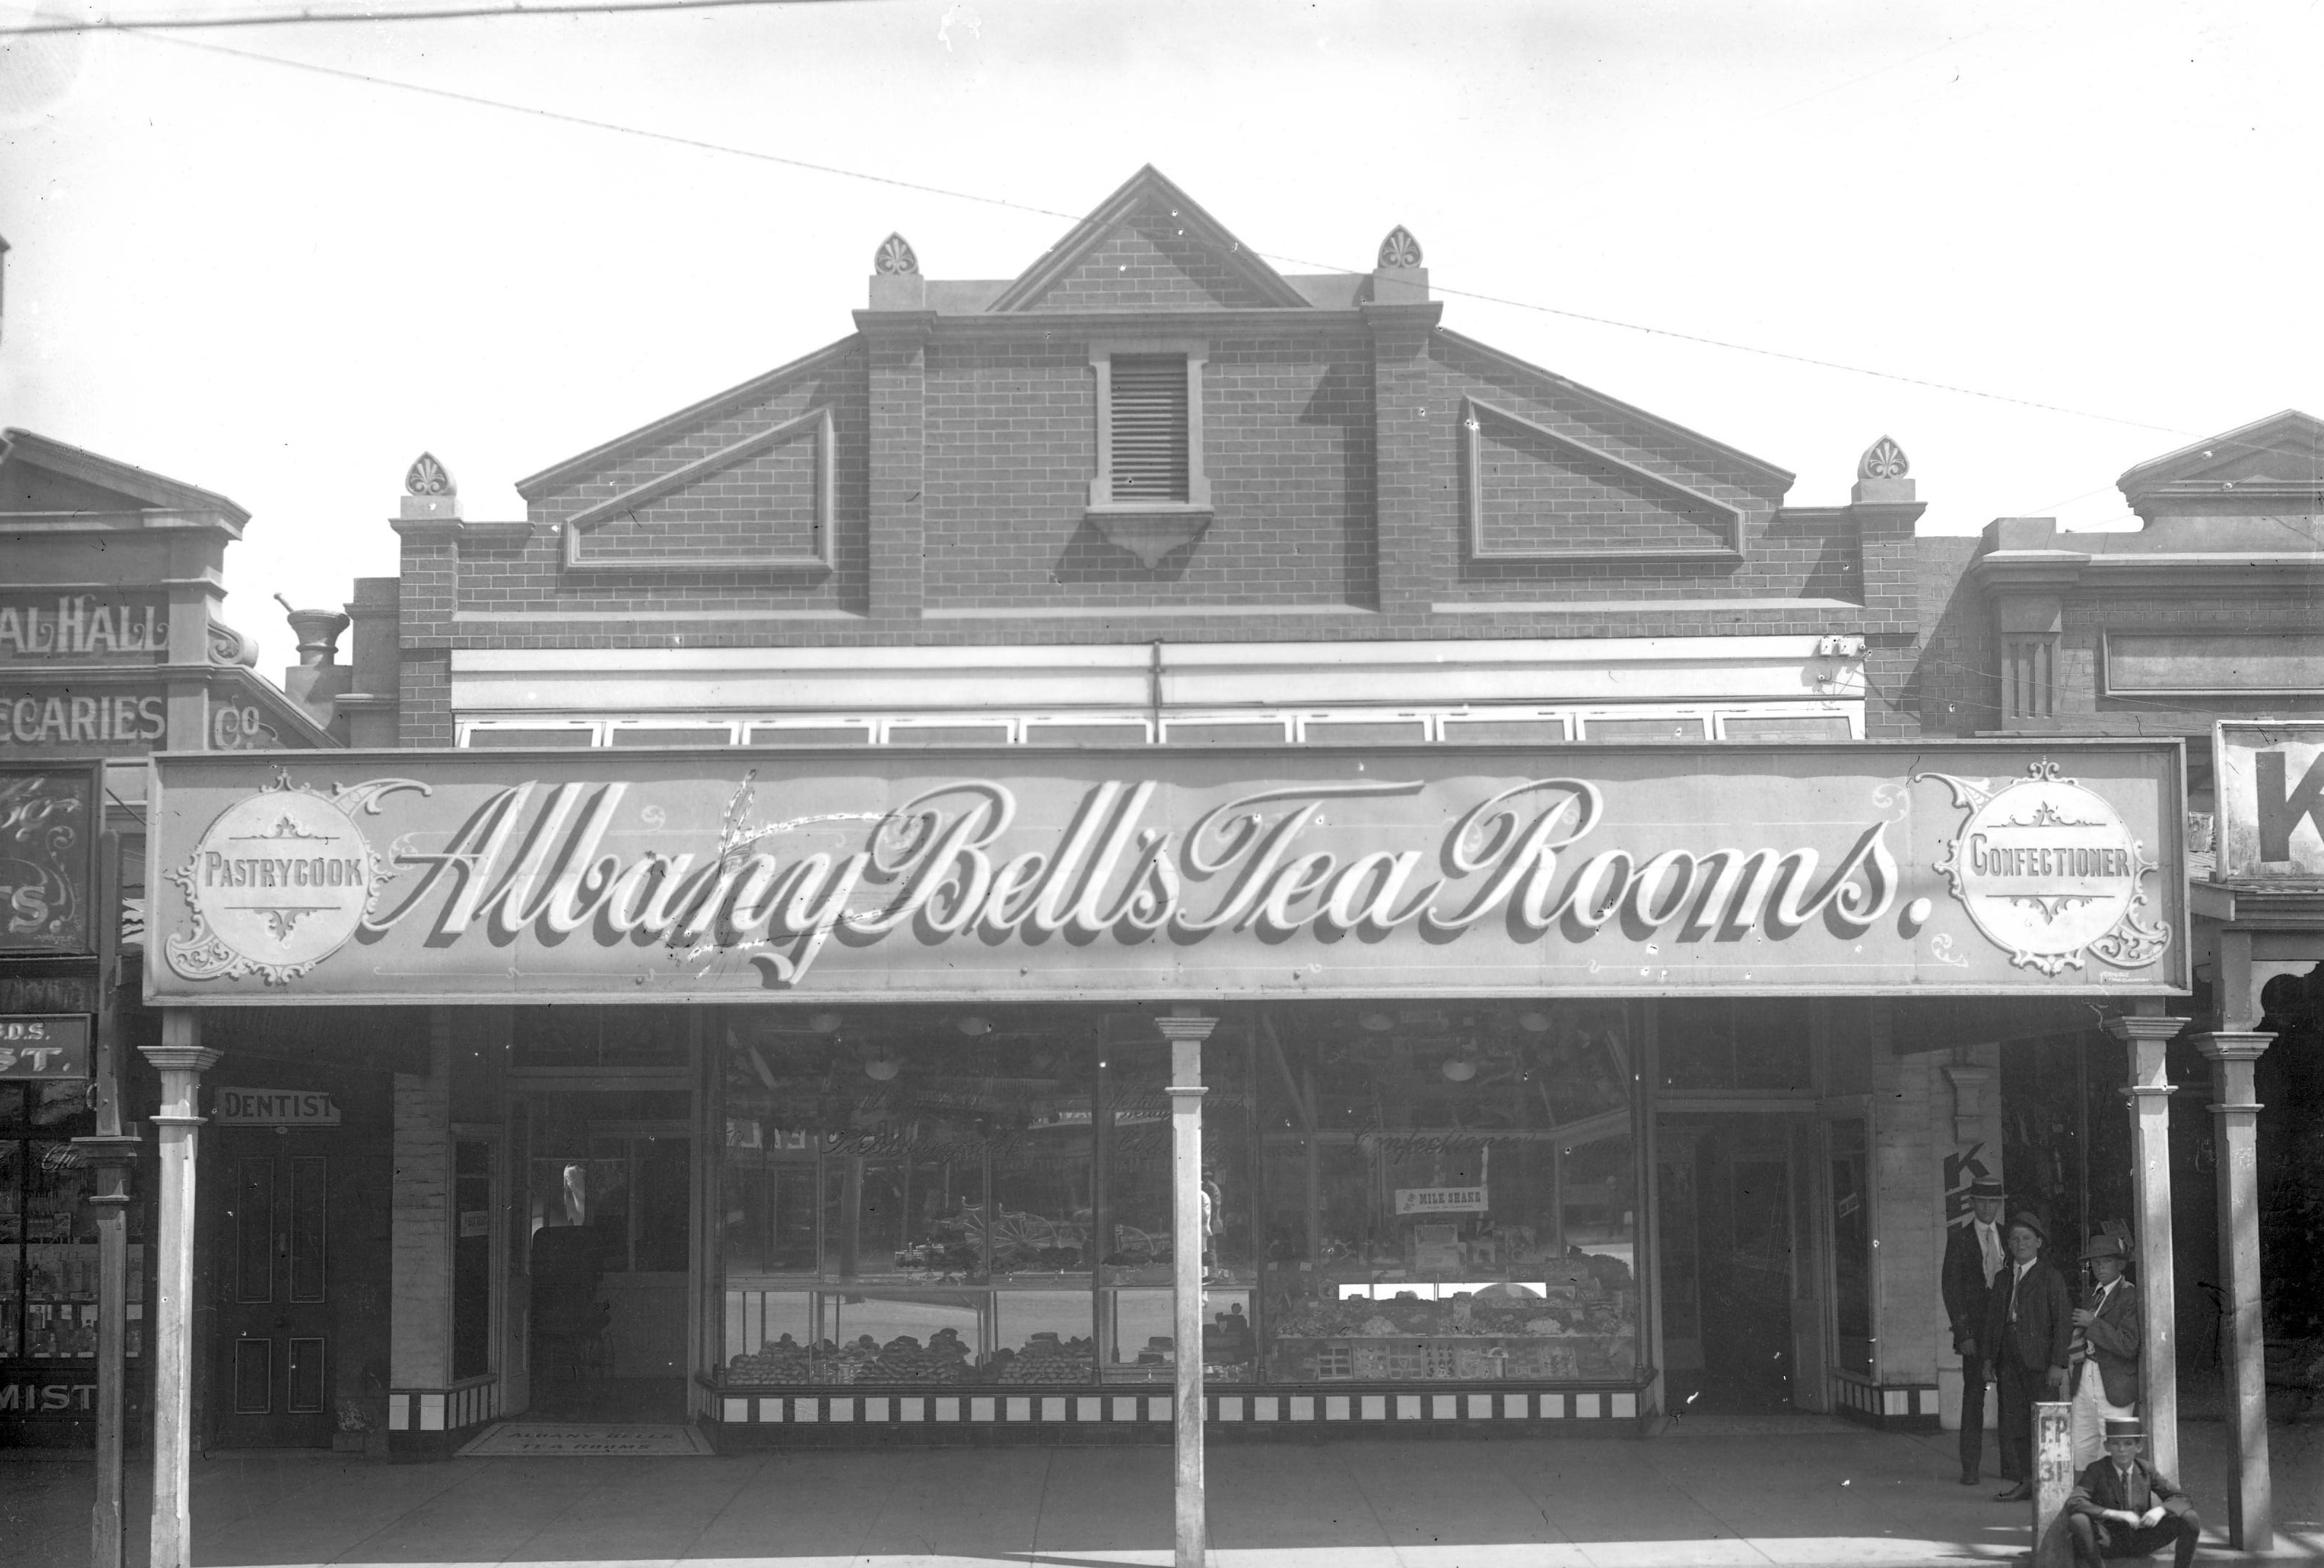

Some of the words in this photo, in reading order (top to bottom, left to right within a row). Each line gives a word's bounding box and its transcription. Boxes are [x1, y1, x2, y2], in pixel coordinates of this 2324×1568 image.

[355, 780, 872, 989] Albany
[845, 780, 1182, 947] Bell's
[1180, 780, 1443, 946] Tea
[1429, 778, 1931, 946] Rooms.
[225, 1092, 333, 1118] DENTIST
[1419, 1192, 1445, 1205] MILK
[1448, 1191, 1481, 1203] SHAKE
